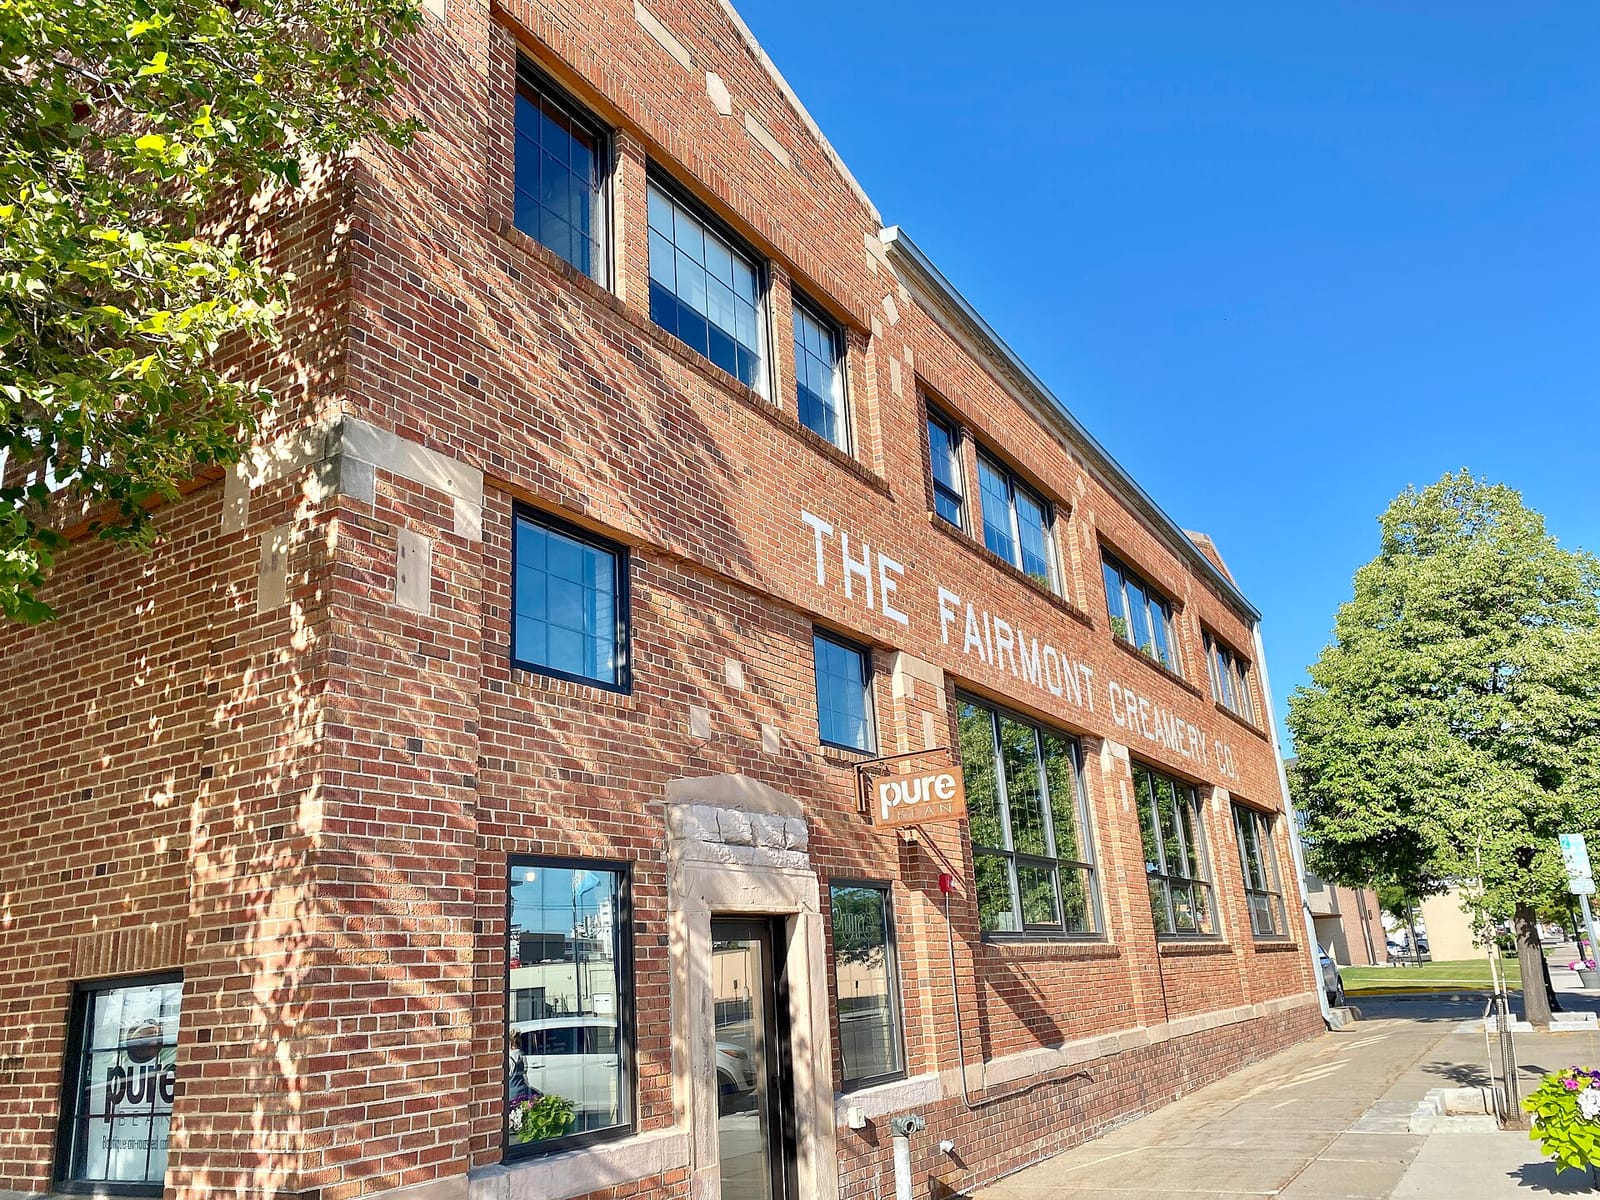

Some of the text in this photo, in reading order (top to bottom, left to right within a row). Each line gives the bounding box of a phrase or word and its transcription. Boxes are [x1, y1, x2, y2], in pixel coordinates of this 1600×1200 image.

[801, 509, 909, 626] THE
[938, 585, 1094, 713] FAIRMONT
[1108, 680, 1208, 767] CREAMERY
[879, 773, 957, 820] pure
[104, 1063, 177, 1124] pure
